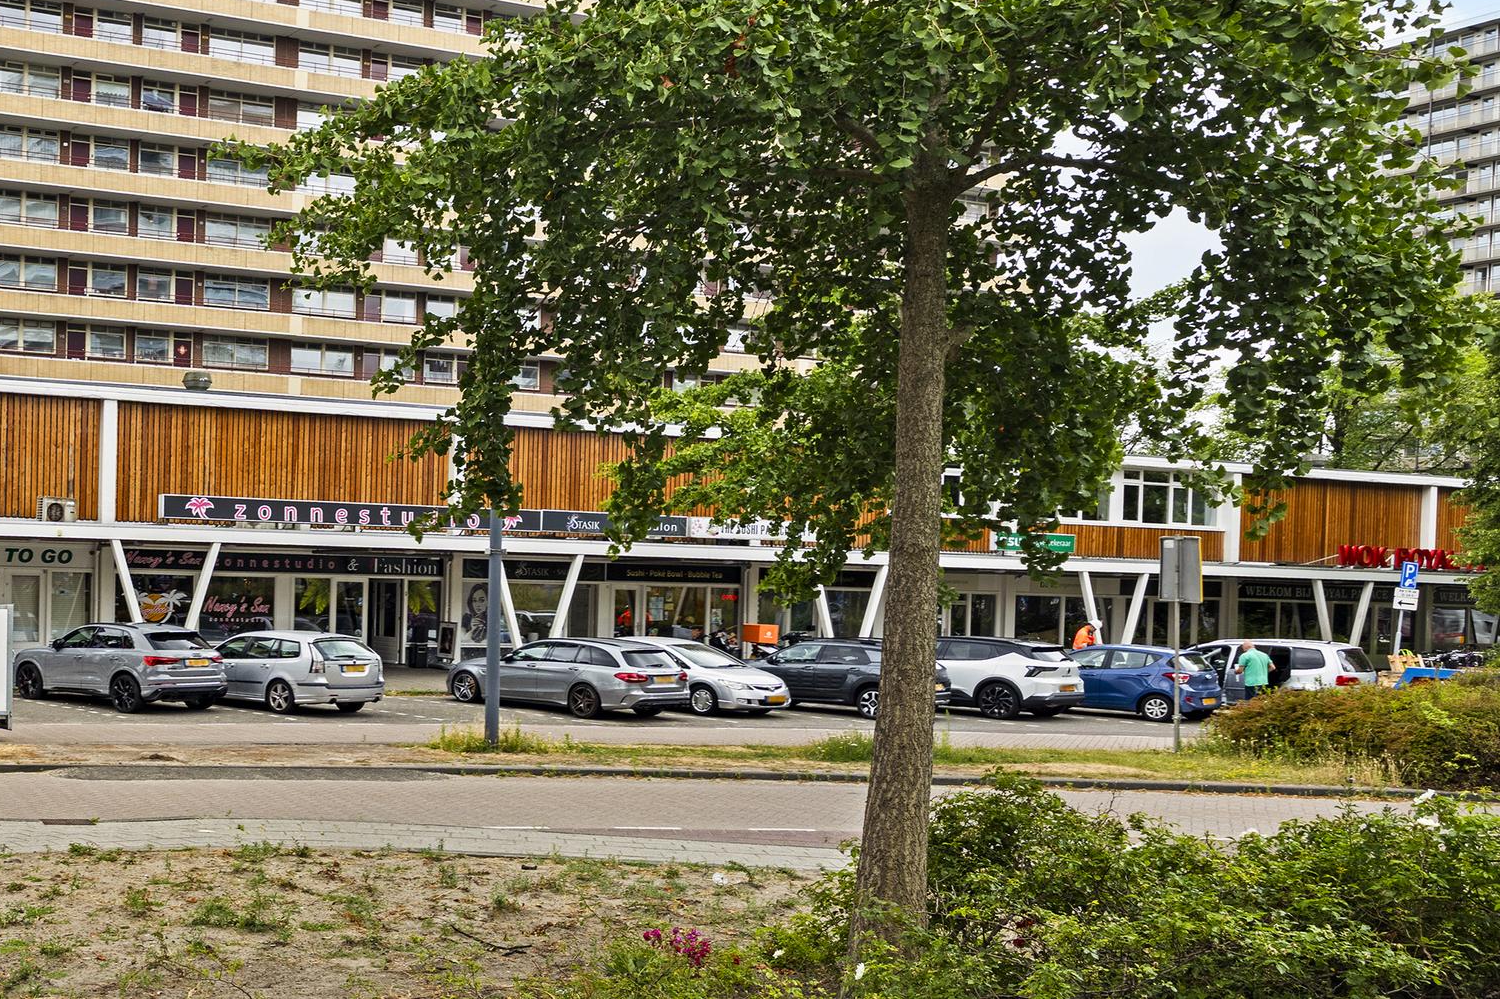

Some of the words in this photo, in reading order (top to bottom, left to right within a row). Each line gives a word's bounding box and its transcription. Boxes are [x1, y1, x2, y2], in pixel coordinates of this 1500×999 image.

[570, 514, 600, 531] STASIK
[5, 548, 34, 563] TO
[41, 549, 73, 564] GO
[1338, 544, 1388, 567] WOK
[347, 558, 360, 572] &
[373, 557, 437, 575] Fashion
[1405, 564, 1416, 578] P
[1245, 585, 1292, 597] WELKOM
[1295, 587, 1311, 598] BIJ
